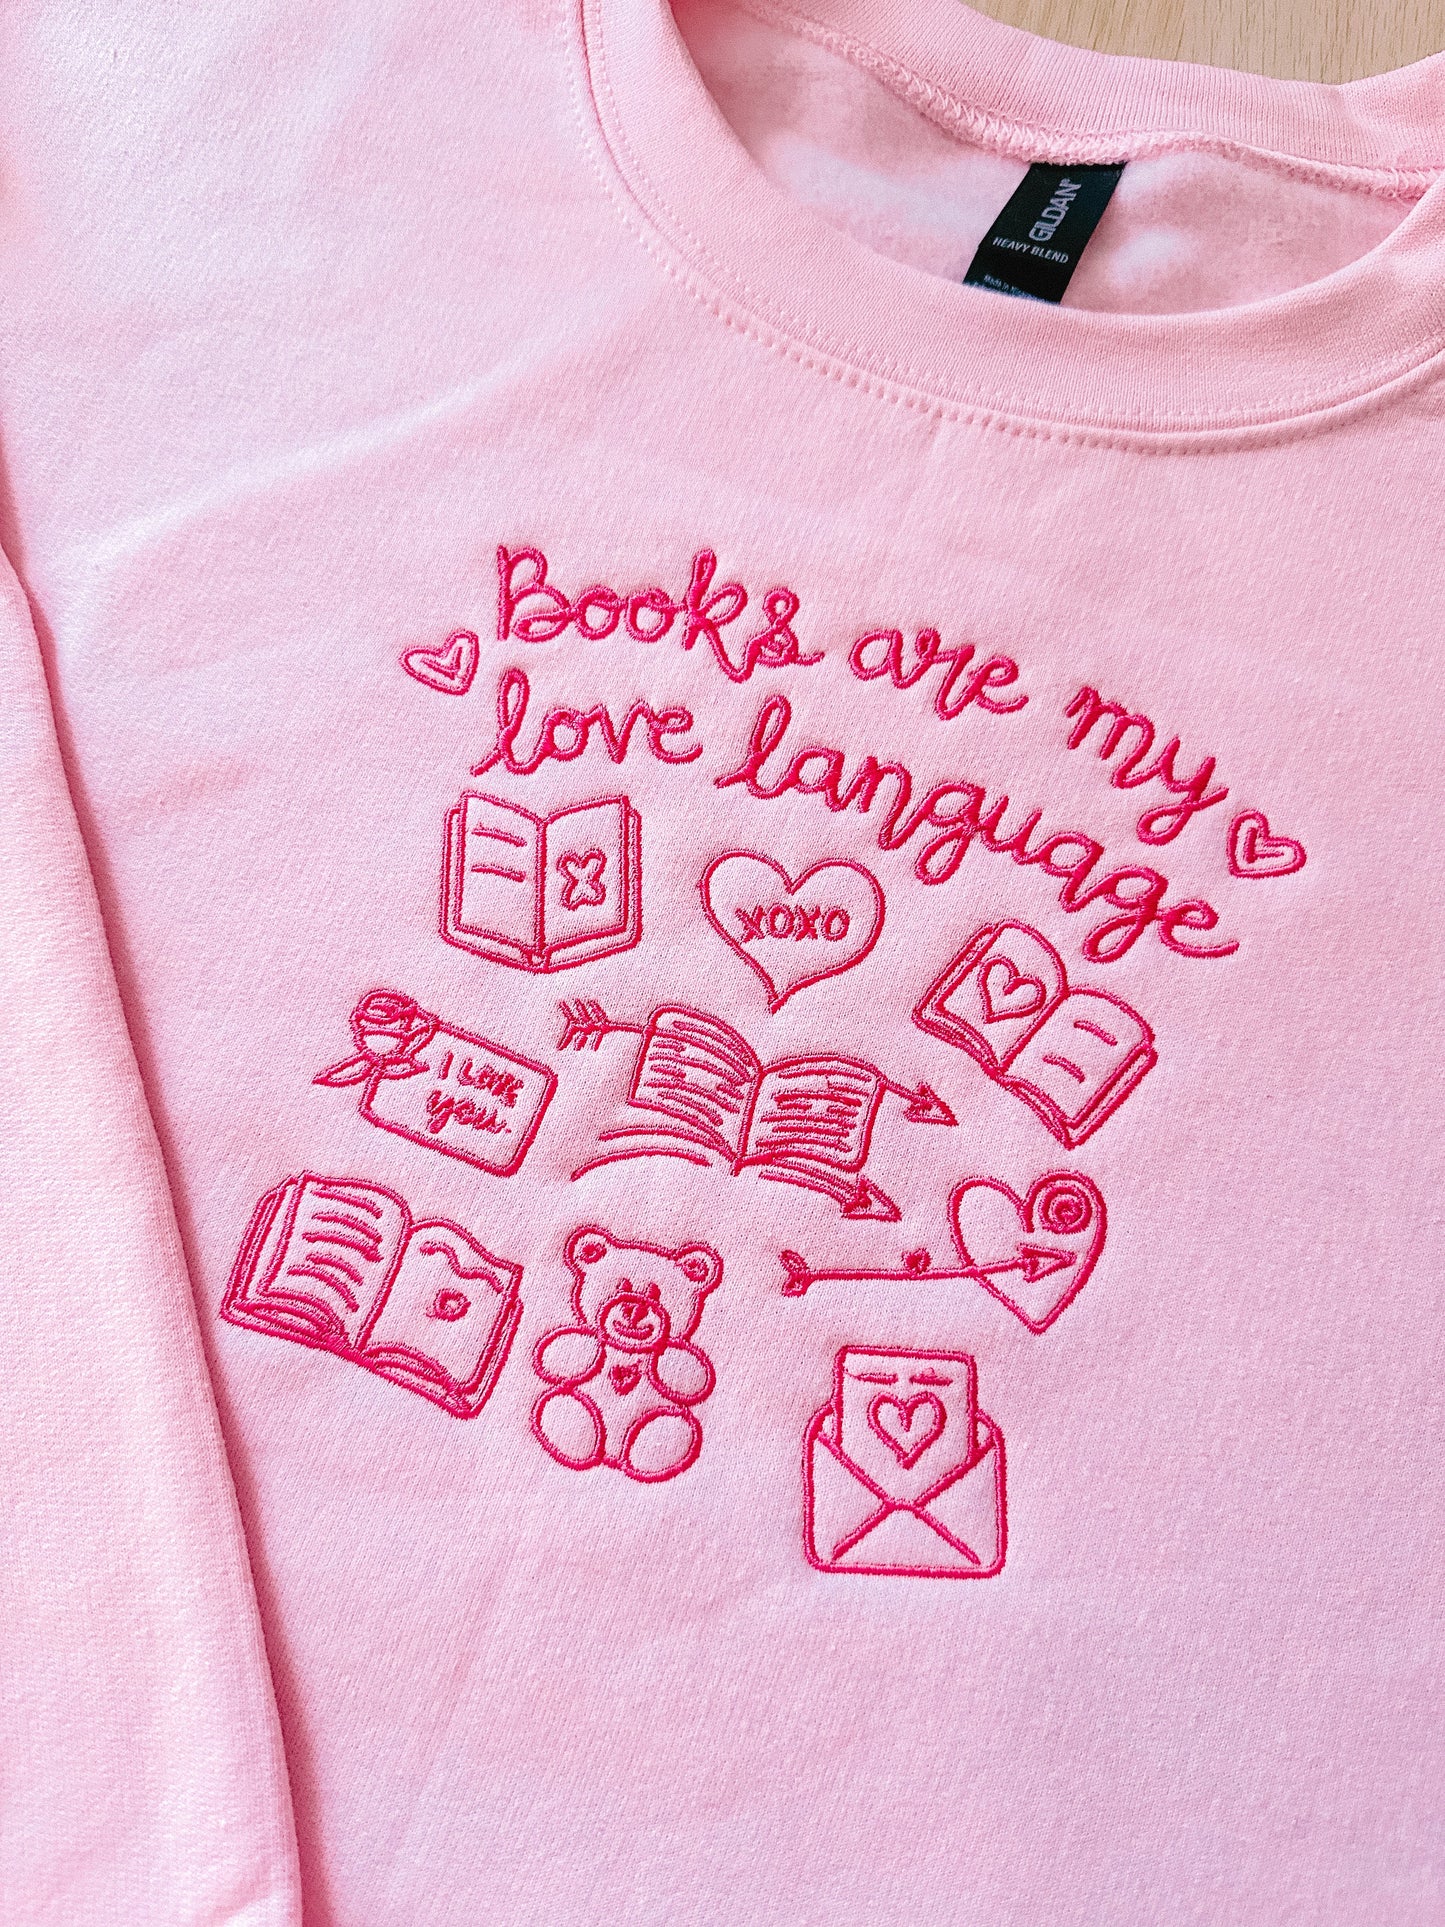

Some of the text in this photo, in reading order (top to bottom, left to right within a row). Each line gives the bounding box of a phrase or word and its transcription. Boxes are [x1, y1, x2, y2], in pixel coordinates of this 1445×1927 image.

[992, 236, 1069, 264] HEAVY BLEND
[496, 544, 1229, 846] Books are my
[469, 667, 1242, 964] love language
[438, 1050, 454, 1080] I
